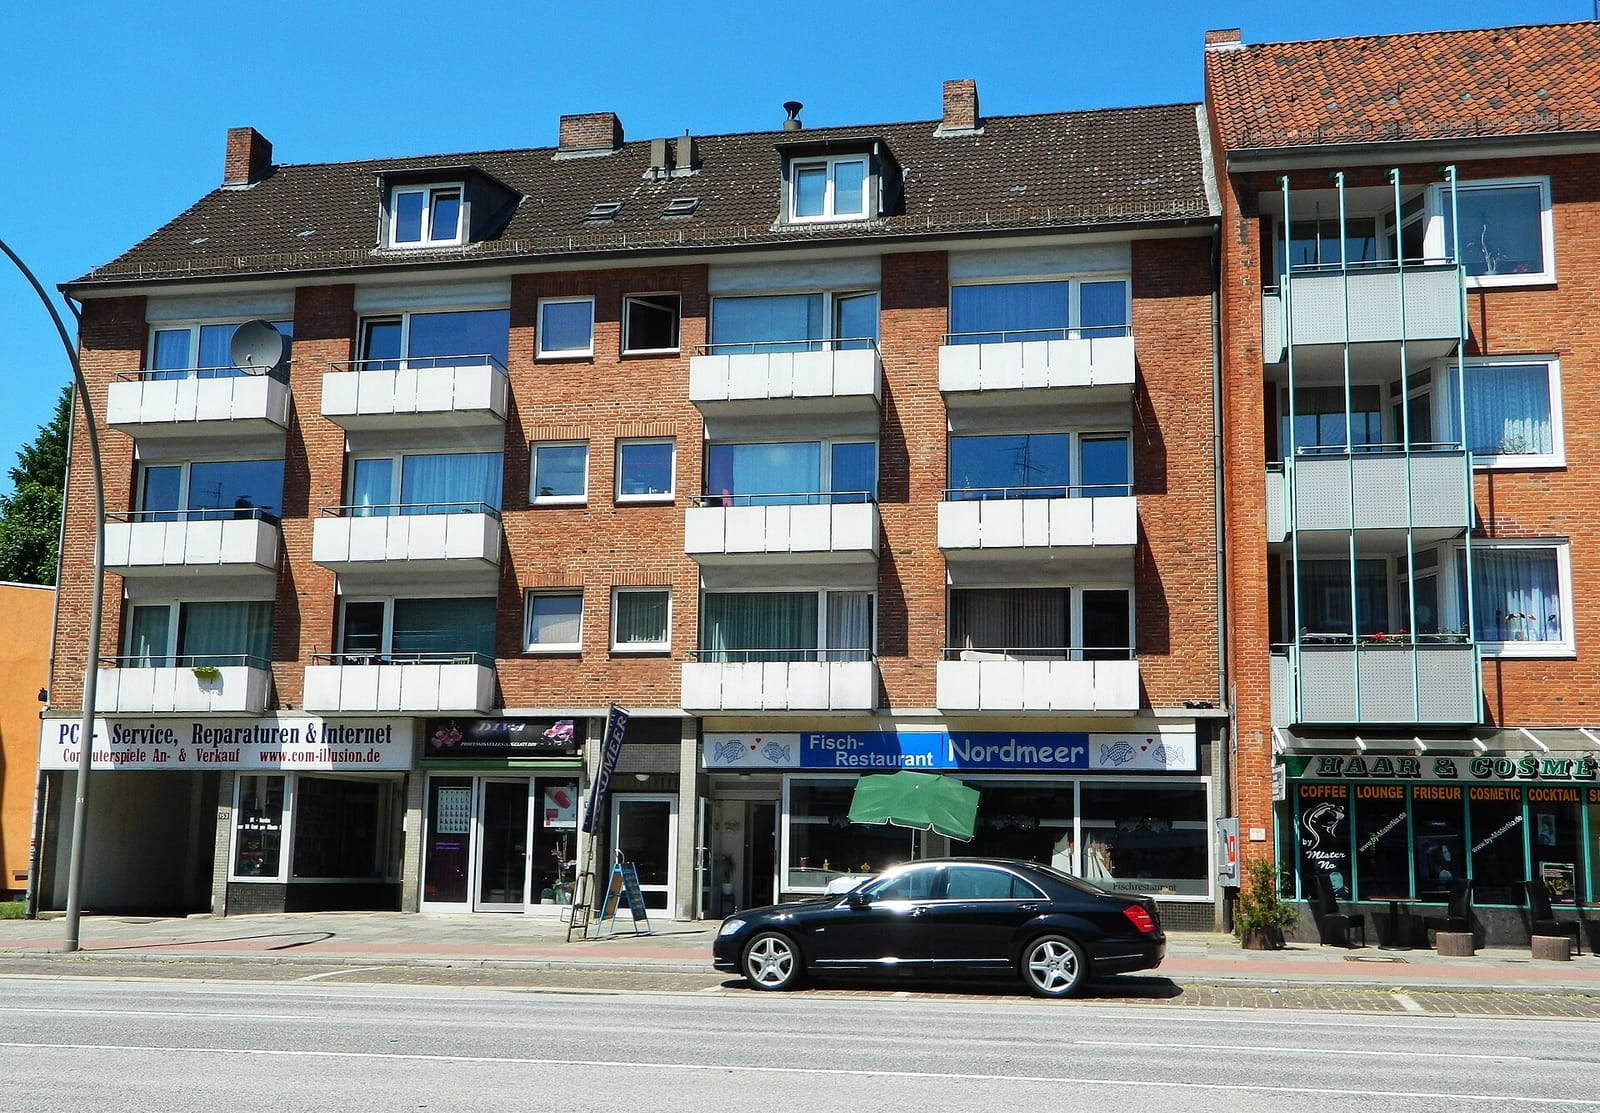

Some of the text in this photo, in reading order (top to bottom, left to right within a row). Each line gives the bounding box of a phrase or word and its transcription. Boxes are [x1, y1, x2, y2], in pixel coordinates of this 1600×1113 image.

[58, 723, 79, 744] PC
[112, 723, 178, 747] Service,
[191, 723, 300, 748] Reparaturen
[305, 722, 317, 744] &
[320, 722, 392, 744] Internet
[809, 735, 865, 750] Fisch-
[63, 748, 381, 765] Couterspiele An- & Verkauf www.com-illusion.de
[835, 751, 934, 766] Restaurant
[948, 738, 1084, 764] Nordmeer
[1316, 756, 1600, 780] HAAR & COSME
[1300, 785, 1347, 798] COFFEE
[1356, 785, 1404, 799] LOUNGE
[1413, 786, 1462, 800] FRISEUR
[1469, 787, 1521, 800] COSMETIC
[1528, 787, 1580, 801] COCKTAIL
[1301, 838, 1313, 847] by
[1305, 850, 1346, 860] Mister
[1317, 860, 1337, 870] No
